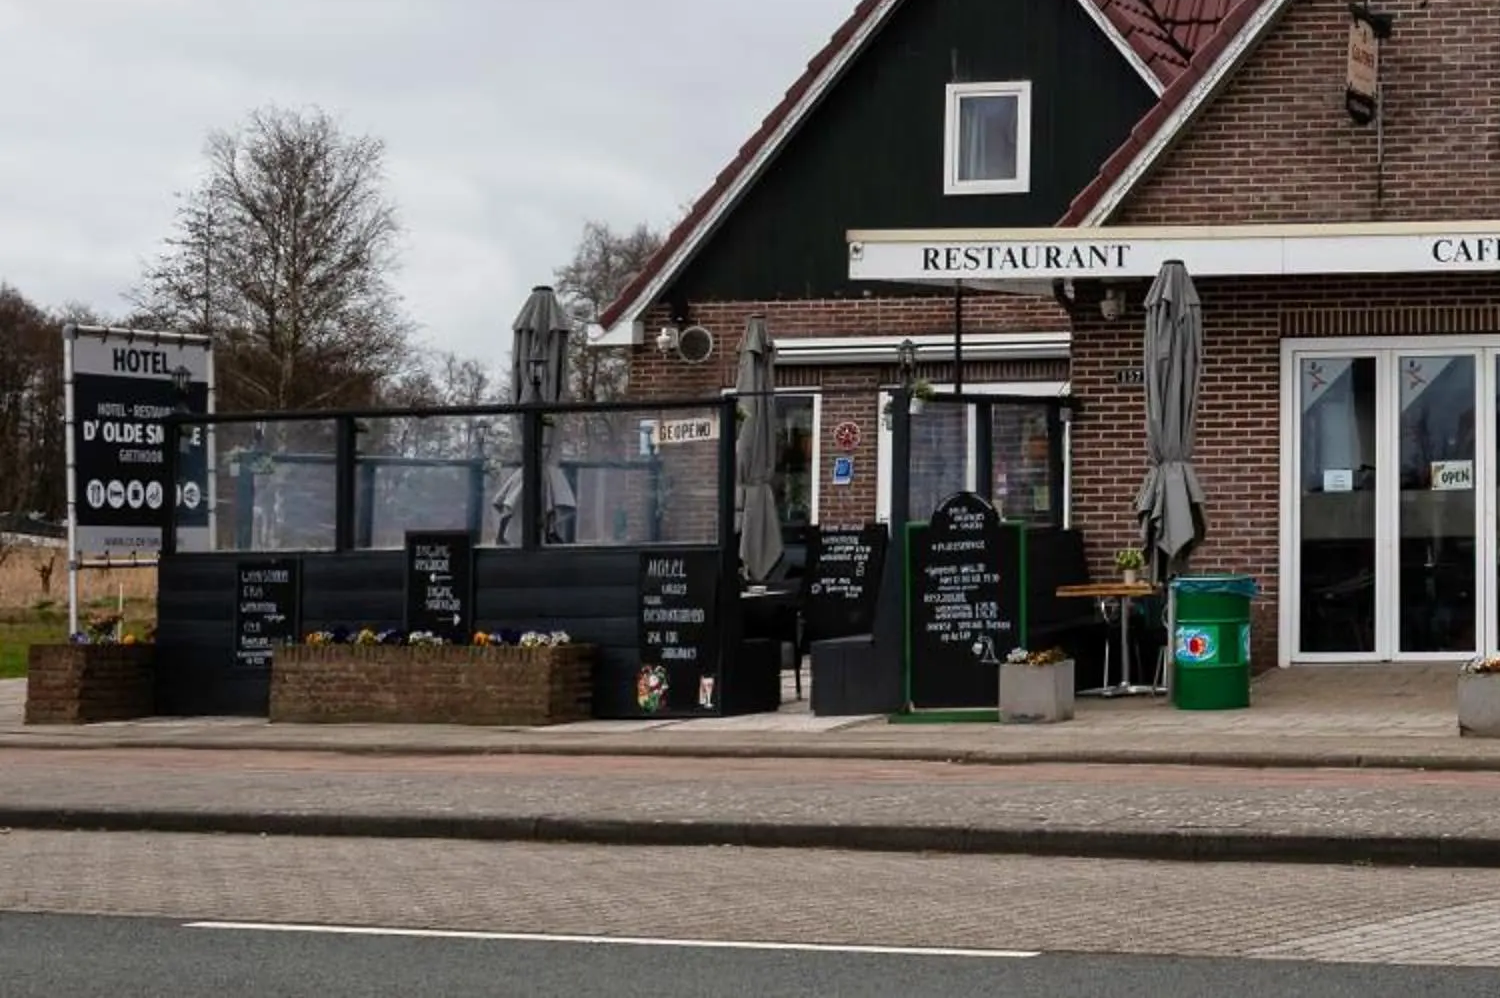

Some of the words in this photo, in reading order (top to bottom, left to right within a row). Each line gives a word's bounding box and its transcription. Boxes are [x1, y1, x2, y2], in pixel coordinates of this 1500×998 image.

[922, 244, 1131, 271] RESTAURANT
[113, 348, 170, 375] HOTEL
[83, 420, 99, 441] D'
[103, 421, 143, 443] OLDE
[660, 421, 711, 441] GEOPEND
[1441, 468, 1470, 484] OPEN
